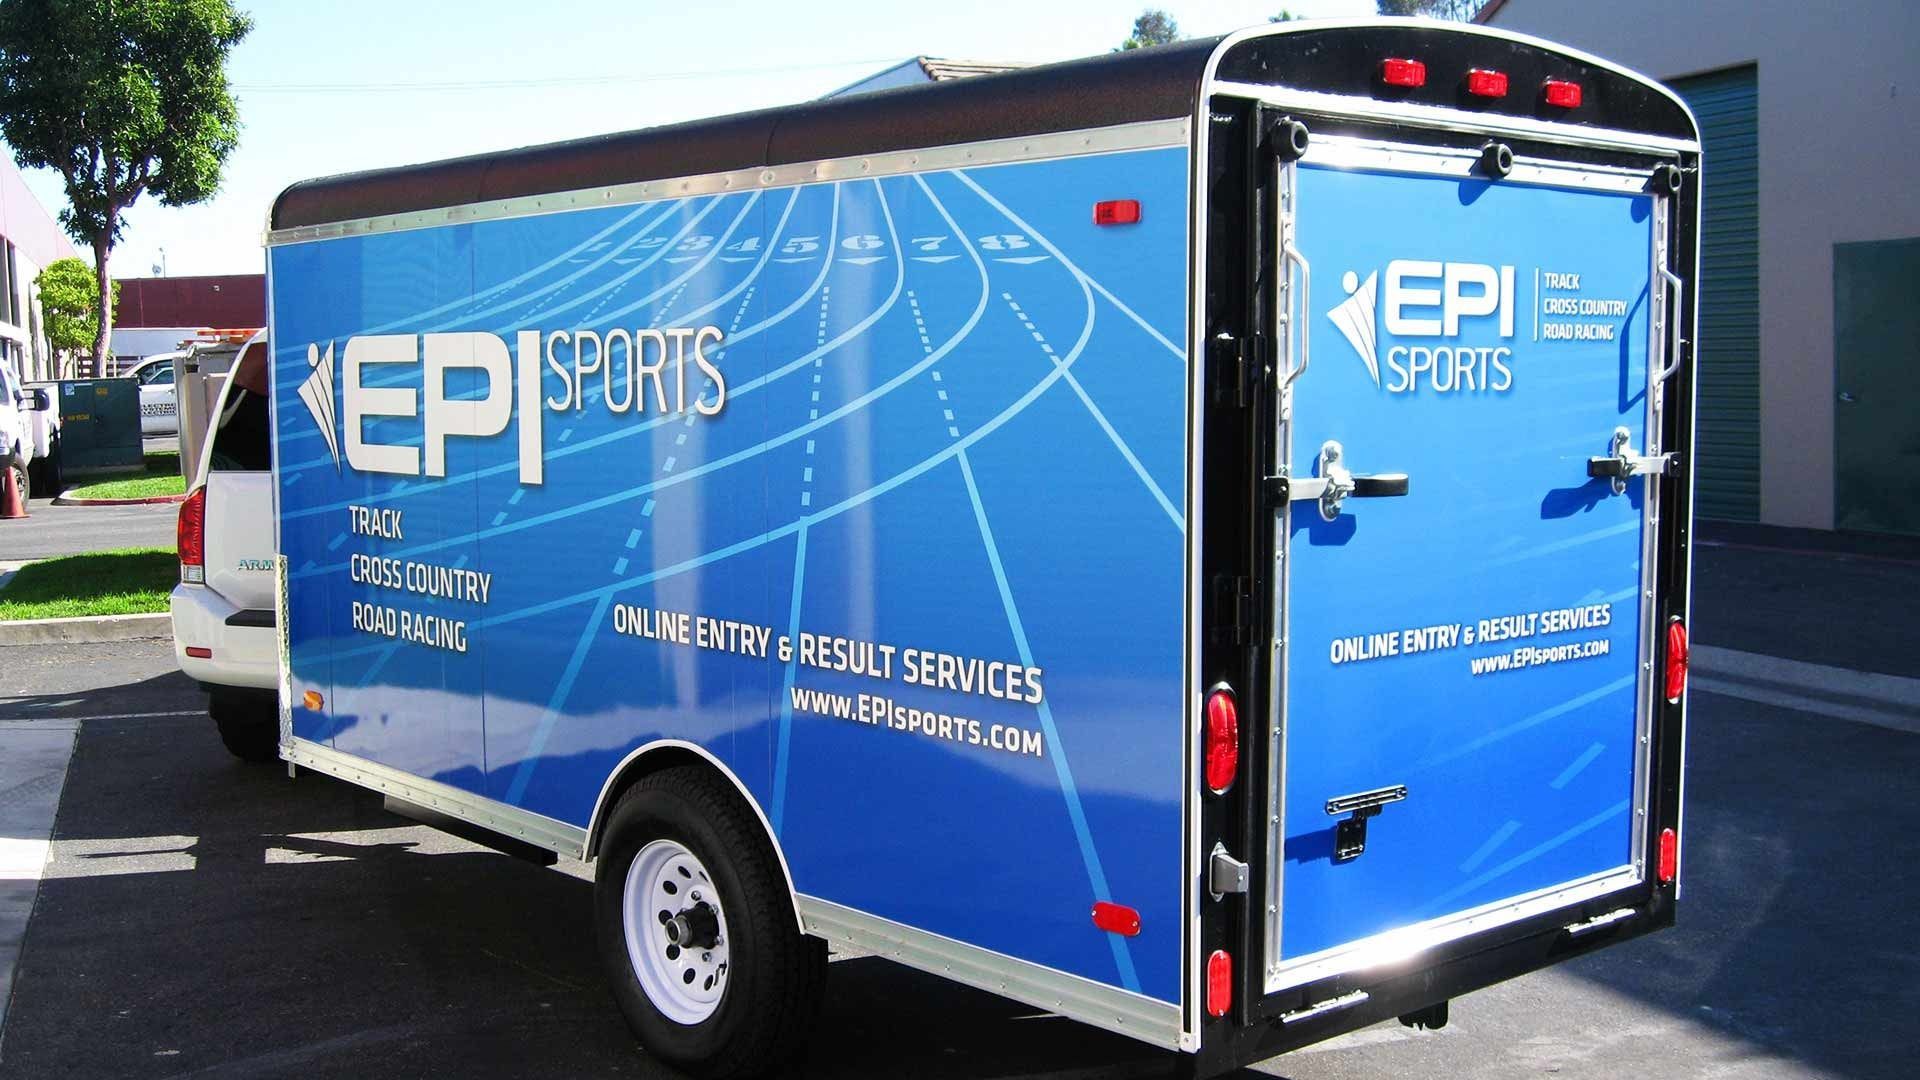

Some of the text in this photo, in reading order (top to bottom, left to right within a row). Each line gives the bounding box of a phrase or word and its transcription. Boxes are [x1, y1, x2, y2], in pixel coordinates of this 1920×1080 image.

[675, 235, 714, 250] 3
[726, 236, 761, 252] 4
[783, 236, 820, 253] 5
[841, 234, 885, 250] 6
[911, 236, 949, 251] 7
[978, 234, 1030, 250] 8
[1384, 259, 1515, 338] EPI
[1543, 272, 1581, 290] TRACK
[1543, 298, 1628, 317] CROSS COUNTRY
[1543, 323, 1614, 341] ROAD RACING
[1386, 345, 1513, 393] SPORTS
[342, 325, 726, 485] EPI SPORTS
[349, 505, 403, 539] TRACK
[350, 553, 492, 604] CROSS COUNTRY
[352, 601, 467, 652] ROAD RACING
[1330, 603, 1611, 664] ONLINE ENTRY & RESULT SERVICES
[613, 603, 1043, 704] ONLINE ENTRY & RESULT SERVICES
